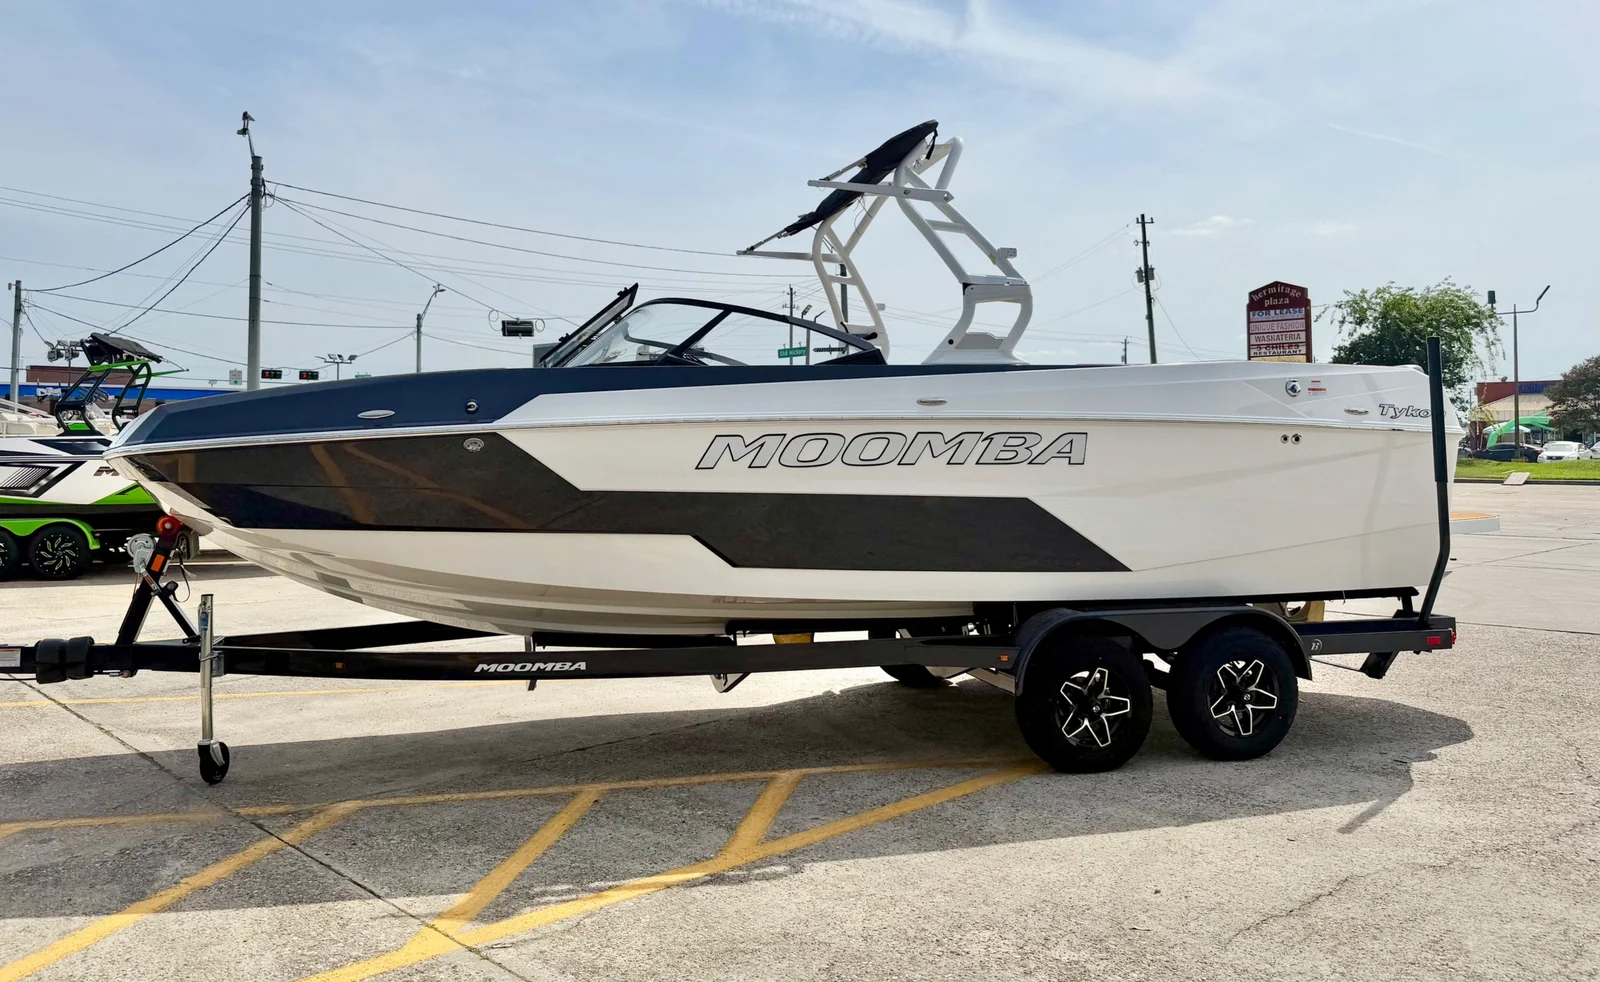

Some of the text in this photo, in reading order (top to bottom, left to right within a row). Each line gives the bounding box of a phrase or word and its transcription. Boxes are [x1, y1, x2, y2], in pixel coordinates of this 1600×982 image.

[1252, 284, 1301, 301] hermitage
[1264, 297, 1289, 307] plaza
[1252, 308, 1304, 318] FOR LEASE
[1250, 321, 1304, 332] UNIQUE FASHION
[789, 348, 807, 356] Hickory
[695, 432, 1088, 469] MOOMBA
[474, 661, 587, 673] MOOMBA
